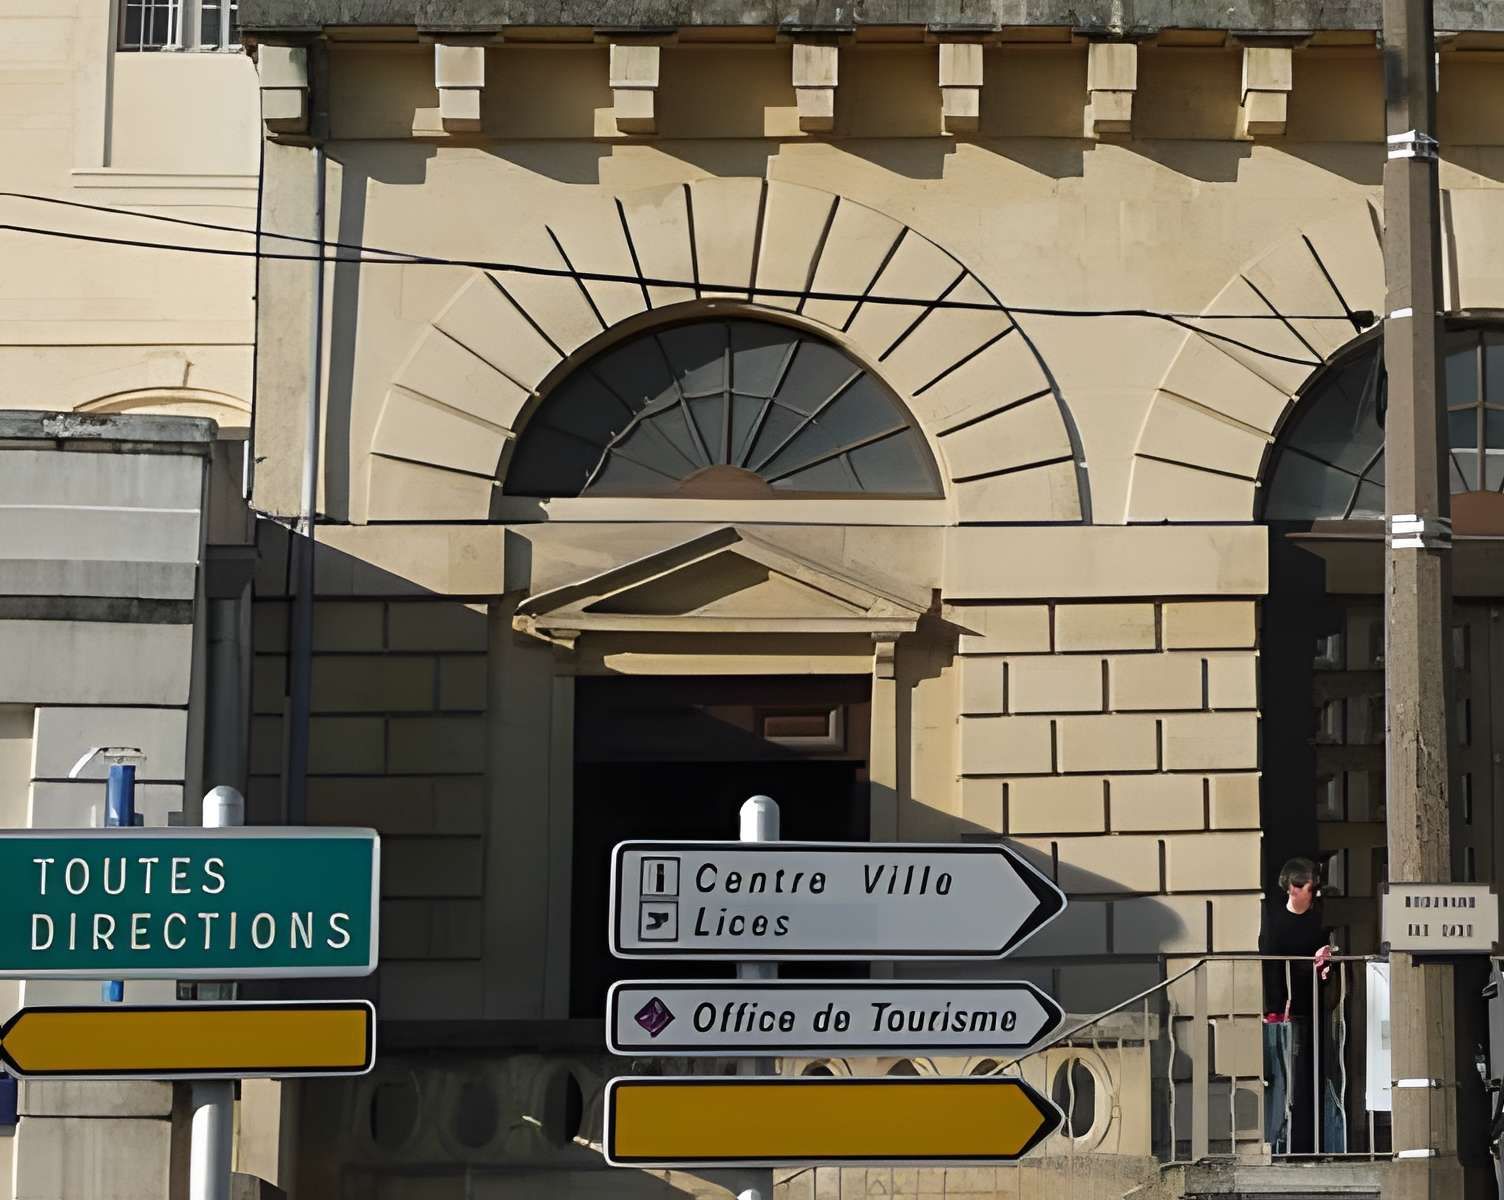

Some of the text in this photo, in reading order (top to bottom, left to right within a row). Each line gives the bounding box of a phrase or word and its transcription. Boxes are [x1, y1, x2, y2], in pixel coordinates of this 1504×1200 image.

[33, 857, 226, 895] TOUTES
[695, 862, 826, 894] Centre
[31, 912, 352, 951] DIRECTIONS
[694, 906, 790, 937] Lices
[693, 1001, 1017, 1033] Office de Tourisme
